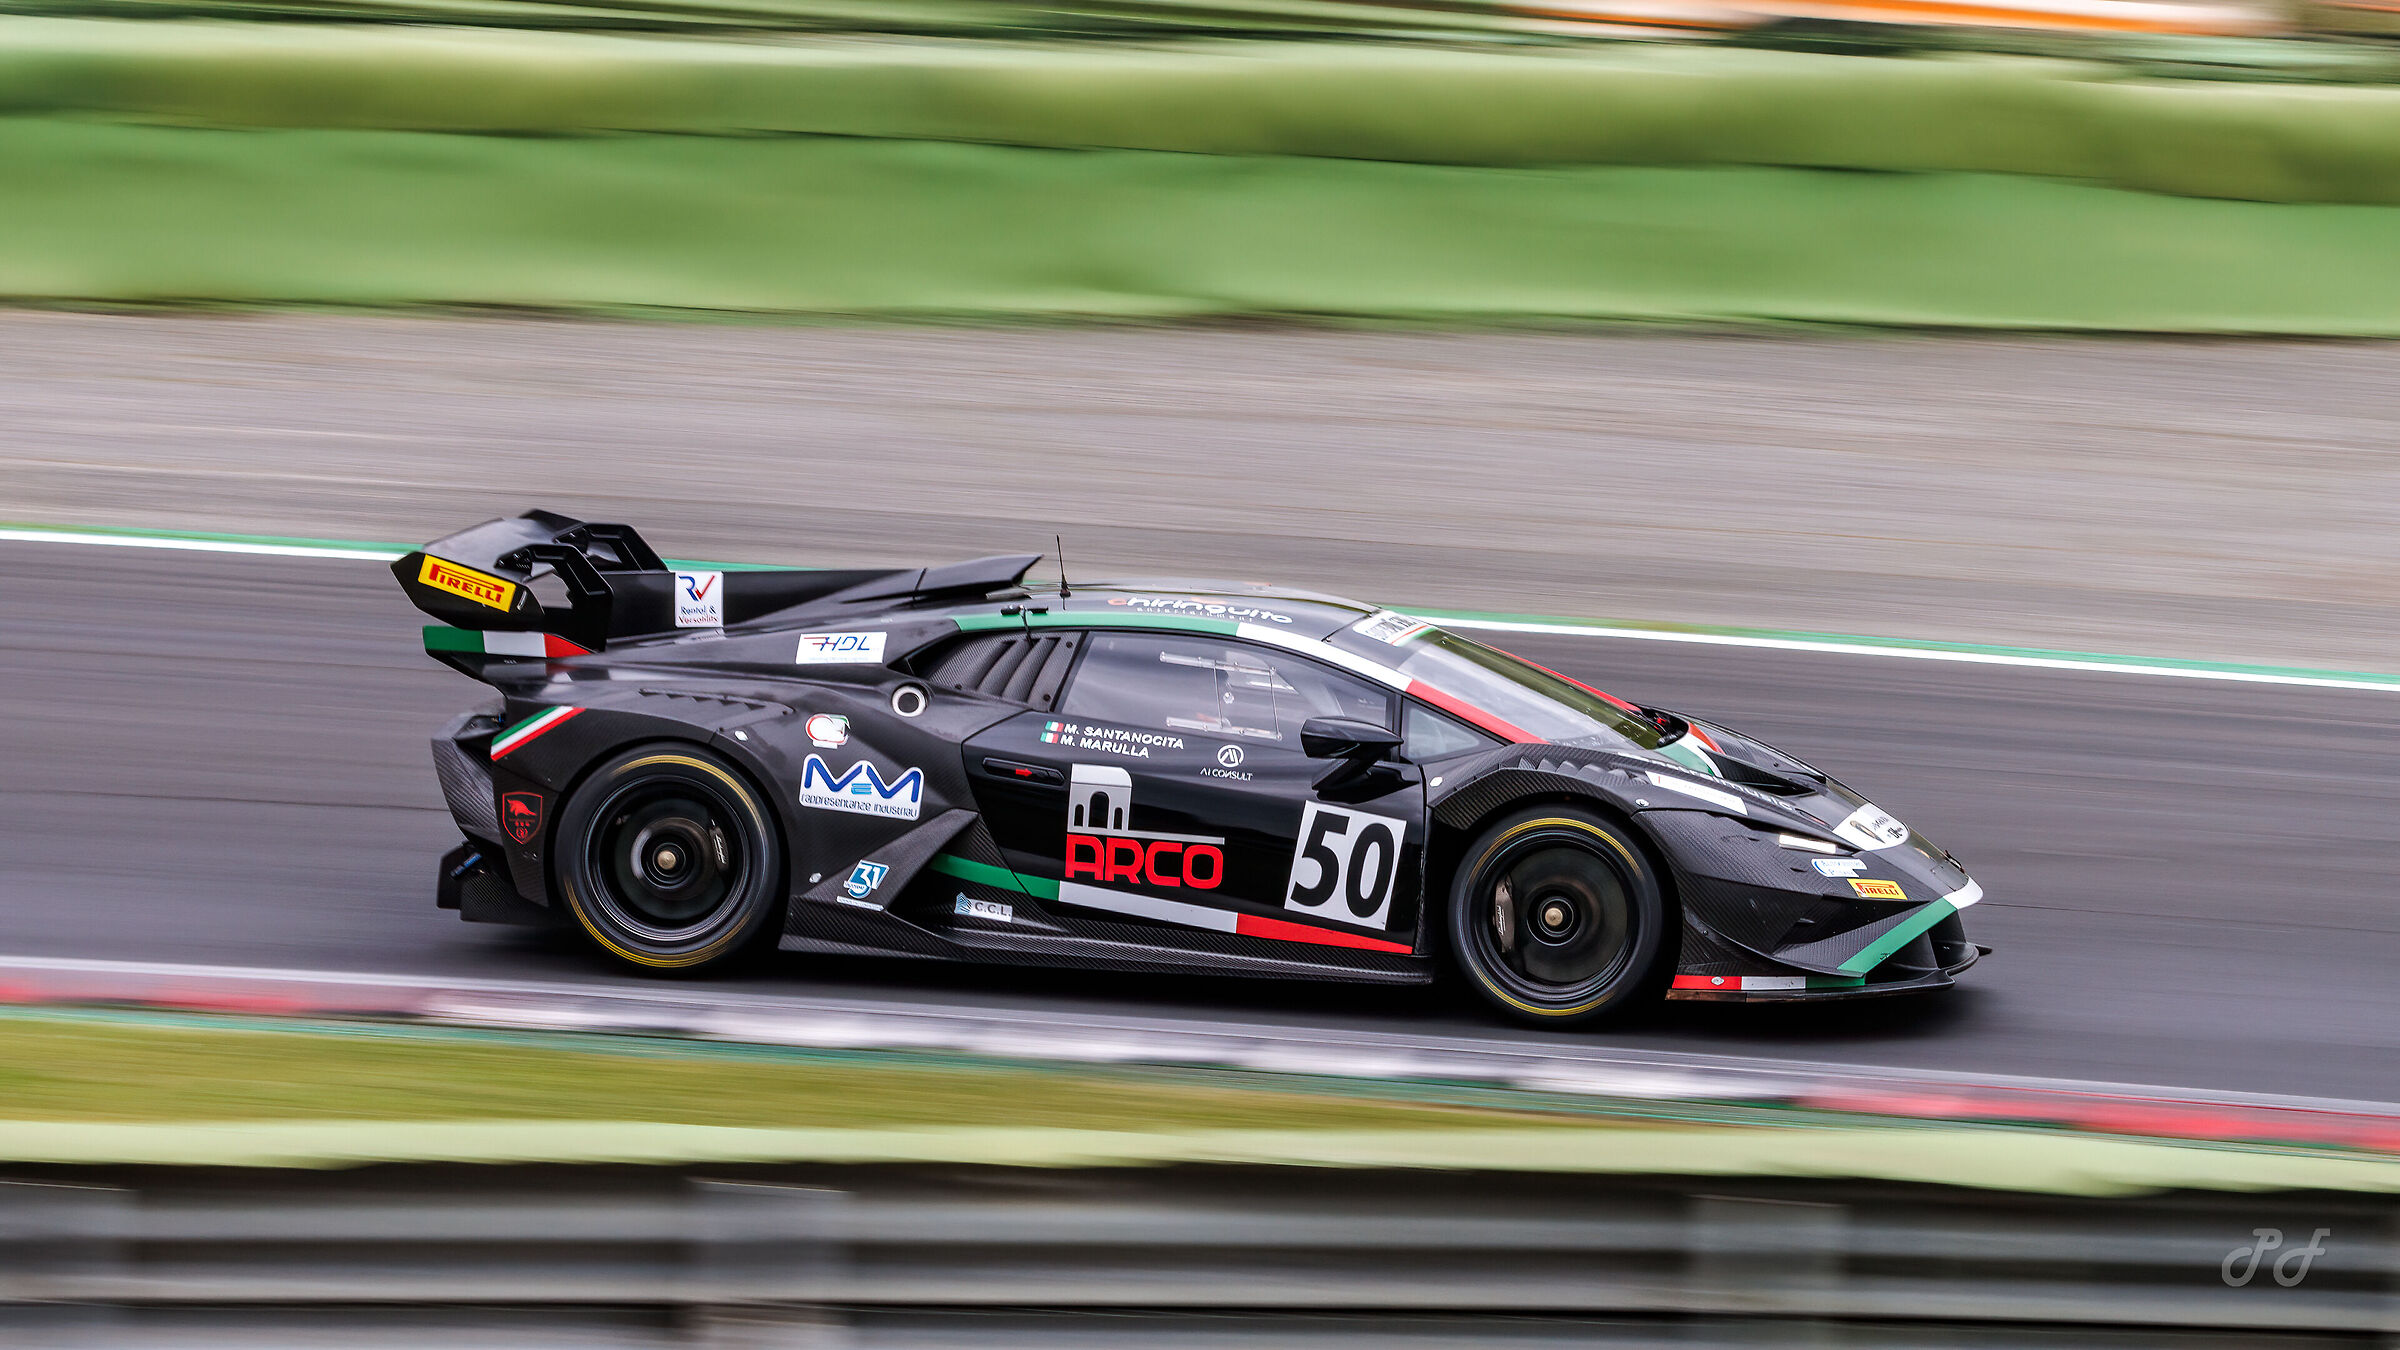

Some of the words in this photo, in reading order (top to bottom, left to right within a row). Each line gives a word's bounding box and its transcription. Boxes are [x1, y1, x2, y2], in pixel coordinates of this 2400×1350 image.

[429, 563, 505, 603] PIRELLI
[819, 635, 870, 651] HDL
[1060, 734, 1076, 747] M.
[1080, 738, 1149, 759] MARULLA
[1064, 723, 1080, 735] M.
[1083, 726, 1184, 750] SANTANOCITA
[1212, 768, 1253, 781] CONSULT
[1065, 833, 1224, 889] ARCO
[1290, 809, 1396, 919] 50
[1855, 882, 1900, 896] PIRELLI
